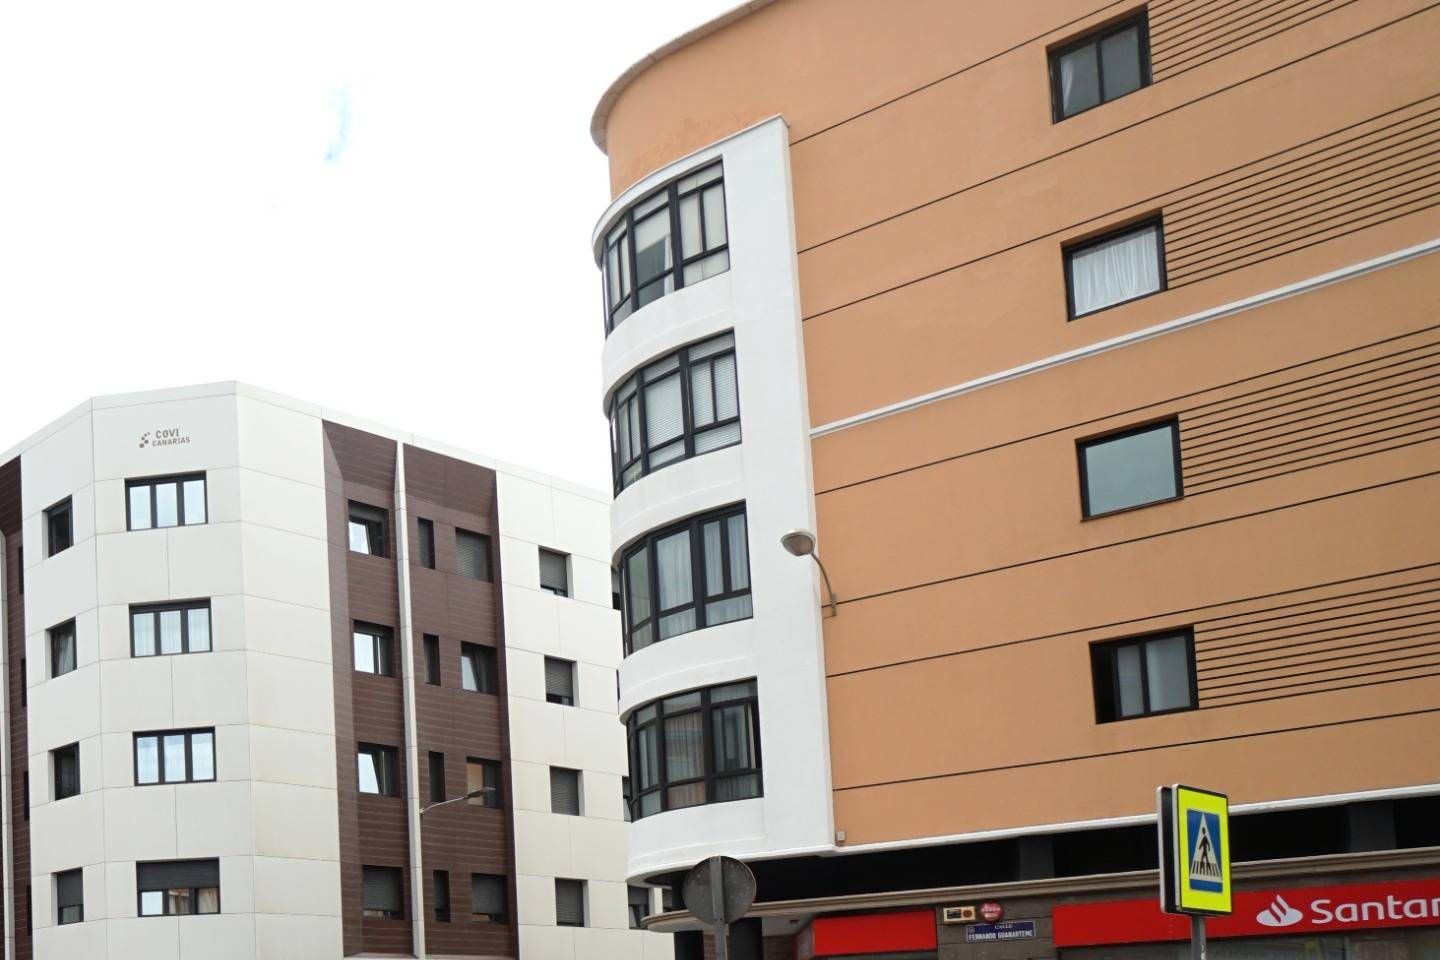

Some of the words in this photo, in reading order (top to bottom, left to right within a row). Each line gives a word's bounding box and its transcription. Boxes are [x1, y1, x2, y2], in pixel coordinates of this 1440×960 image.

[155, 428, 179, 439] COVI
[152, 436, 191, 447] CANARIAS
[1310, 894, 1440, 924] Santa
[968, 932, 996, 941] FERNANDO
